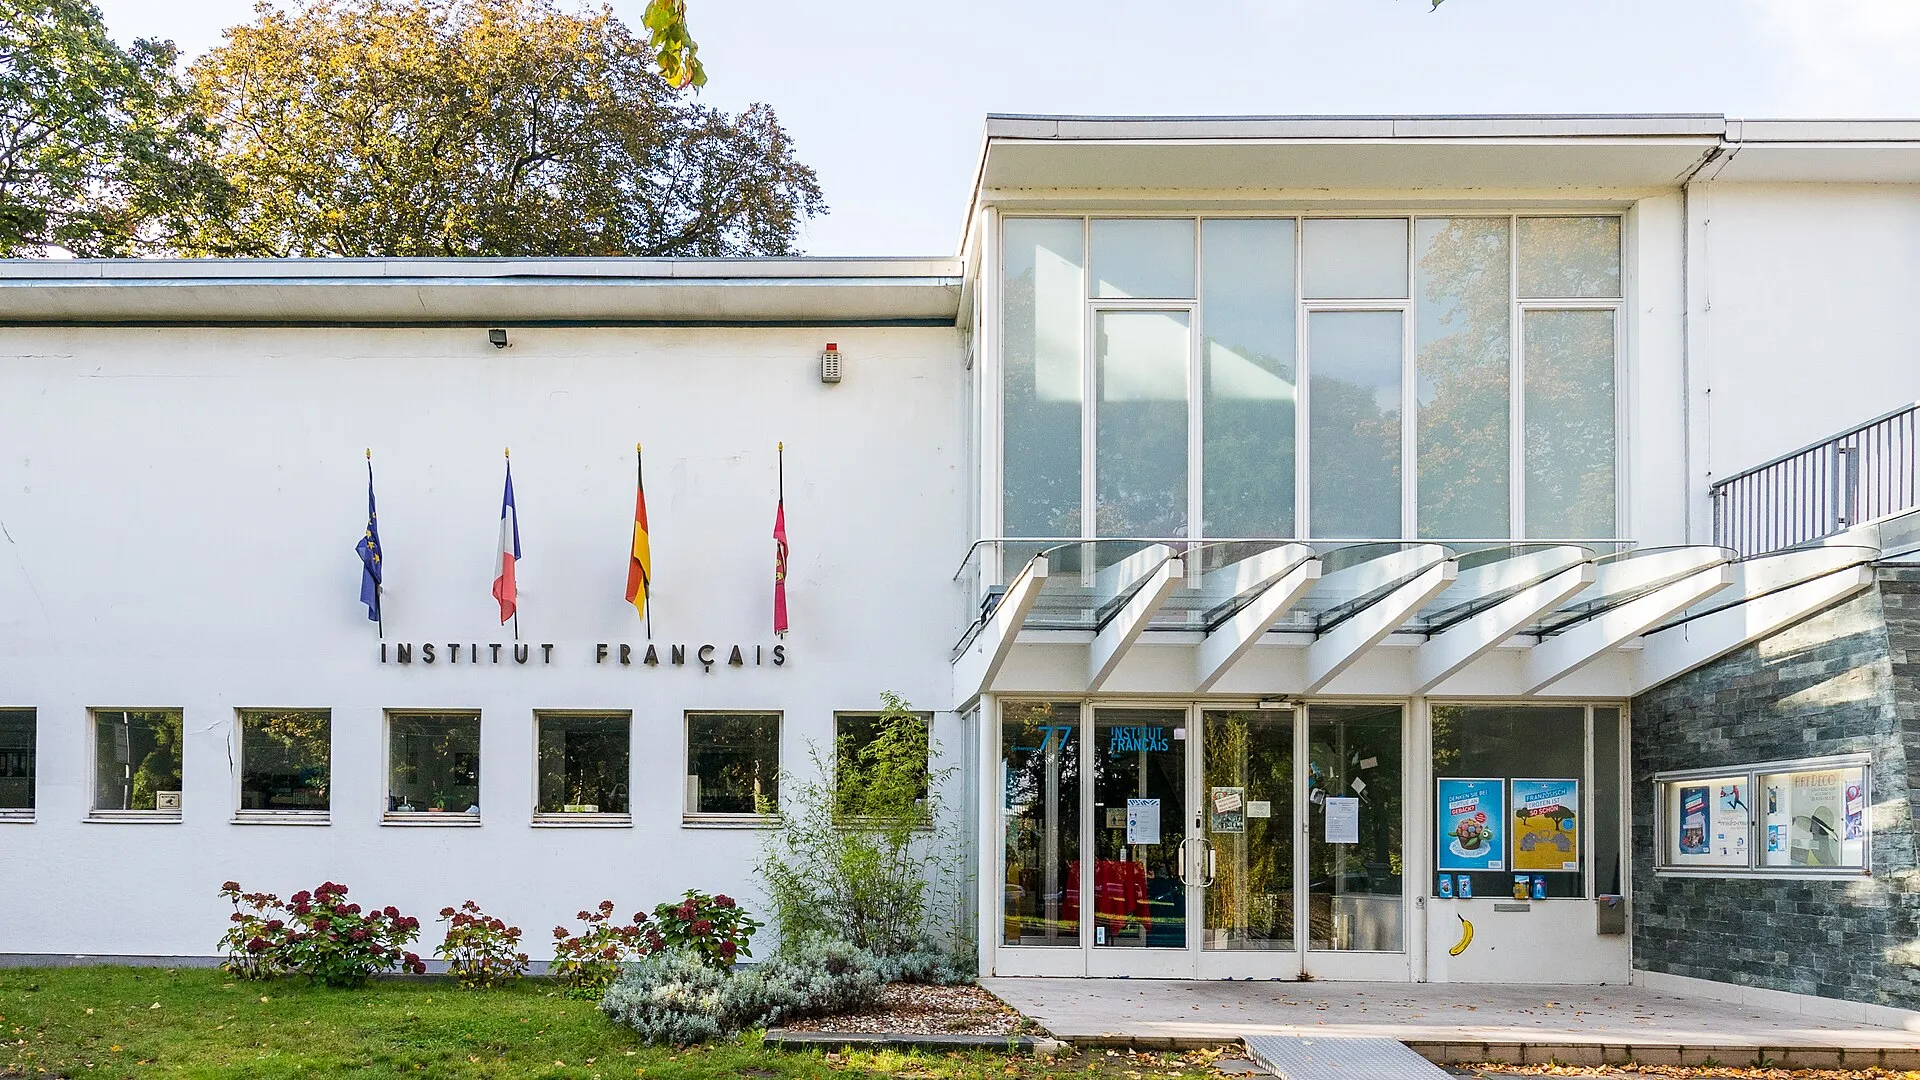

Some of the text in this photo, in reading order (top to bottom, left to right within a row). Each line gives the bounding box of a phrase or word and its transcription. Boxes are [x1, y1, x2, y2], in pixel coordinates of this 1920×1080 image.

[381, 643, 786, 673] INSTITUT FRANÇAIS
[1037, 726, 1072, 751] 77
[1111, 727, 1163, 740] INSTITUT
[1795, 775, 1811, 788] ART
[1530, 809, 1538, 817] SO
